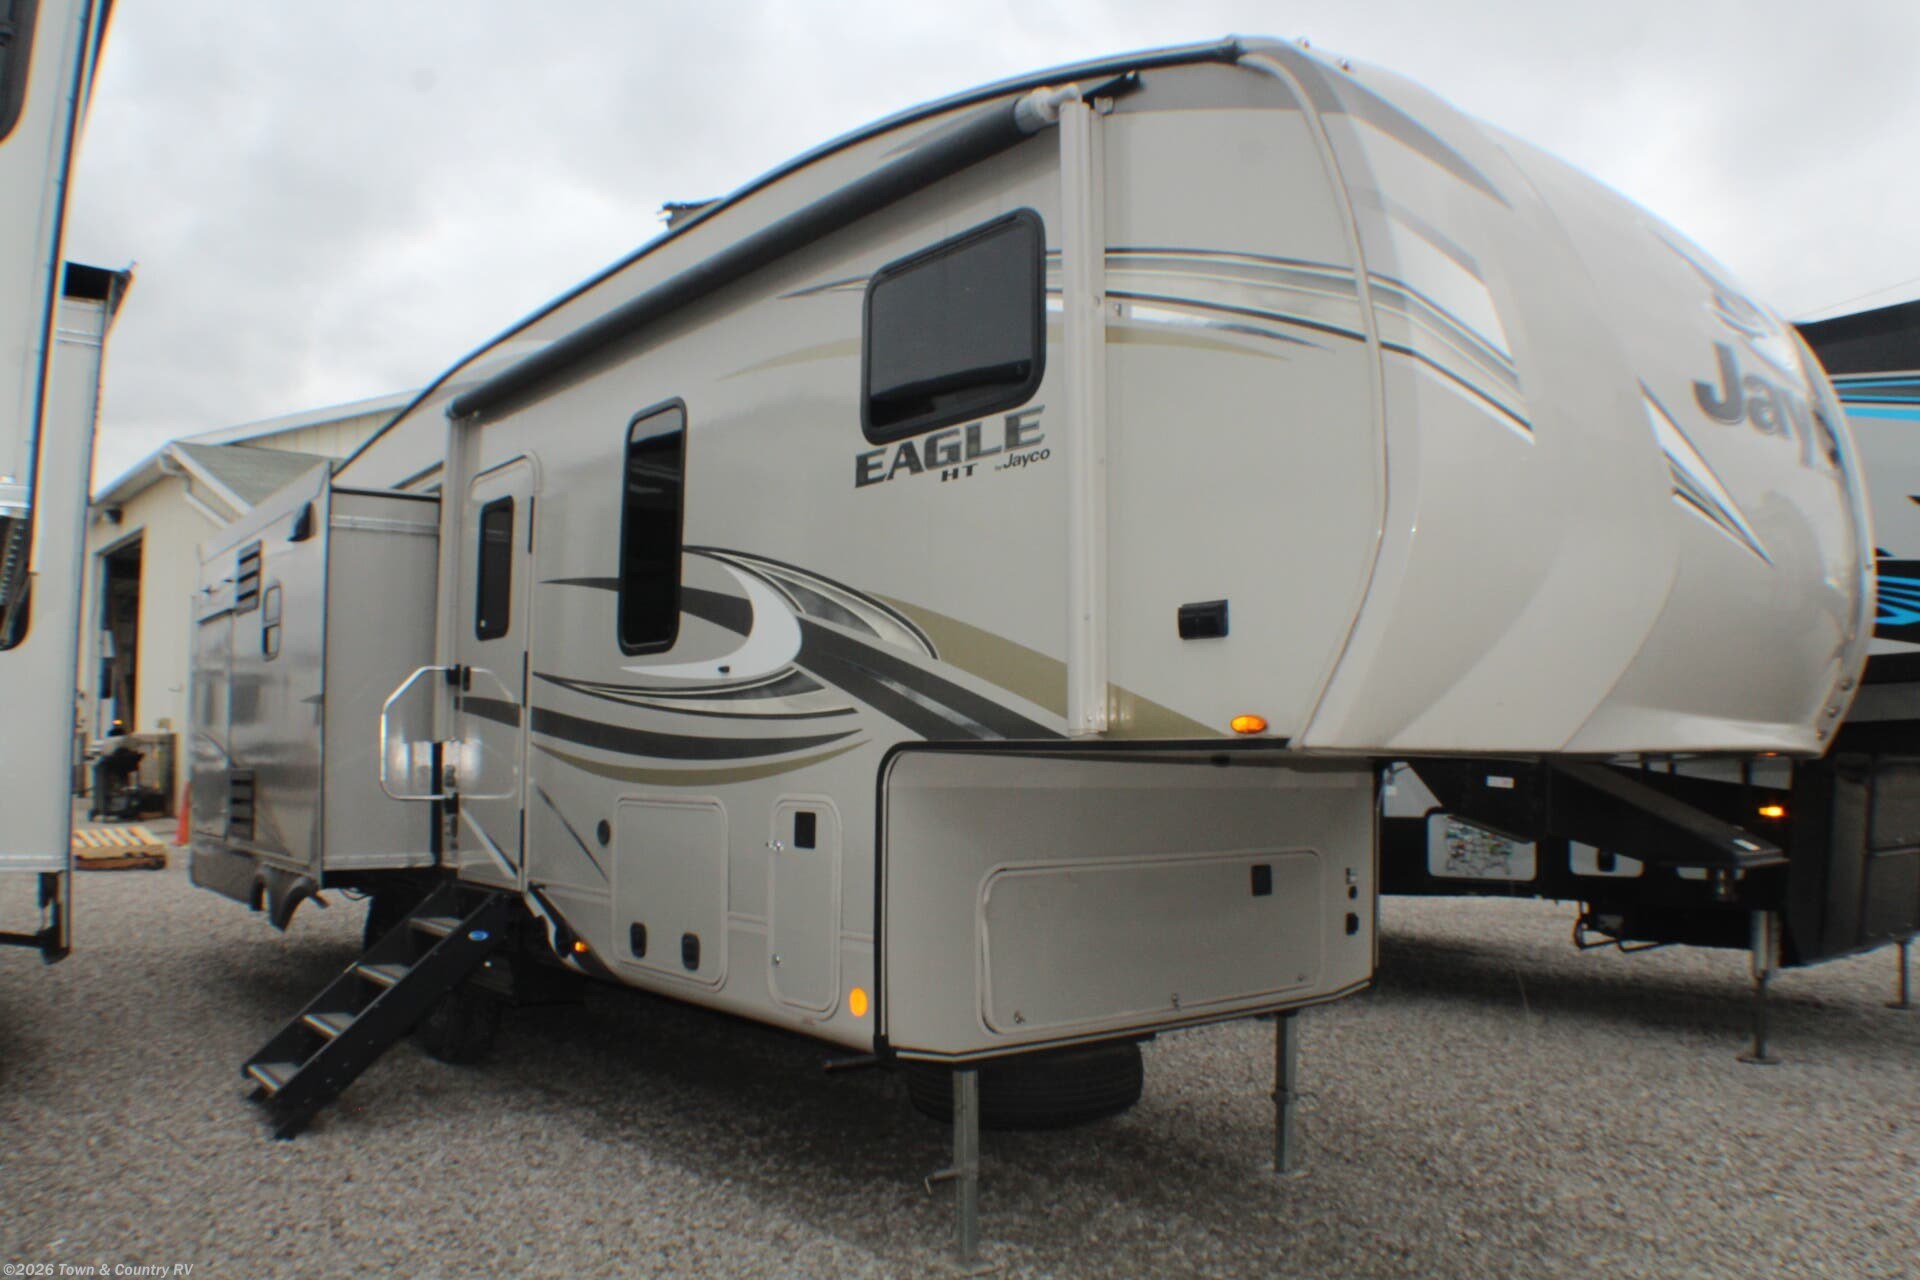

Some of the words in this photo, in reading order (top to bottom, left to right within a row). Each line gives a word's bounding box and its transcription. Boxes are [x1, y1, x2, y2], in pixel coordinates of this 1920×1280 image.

[855, 404, 1046, 489] EAGLE
[1003, 448, 1050, 469] Jayco
[941, 463, 979, 483] HT
